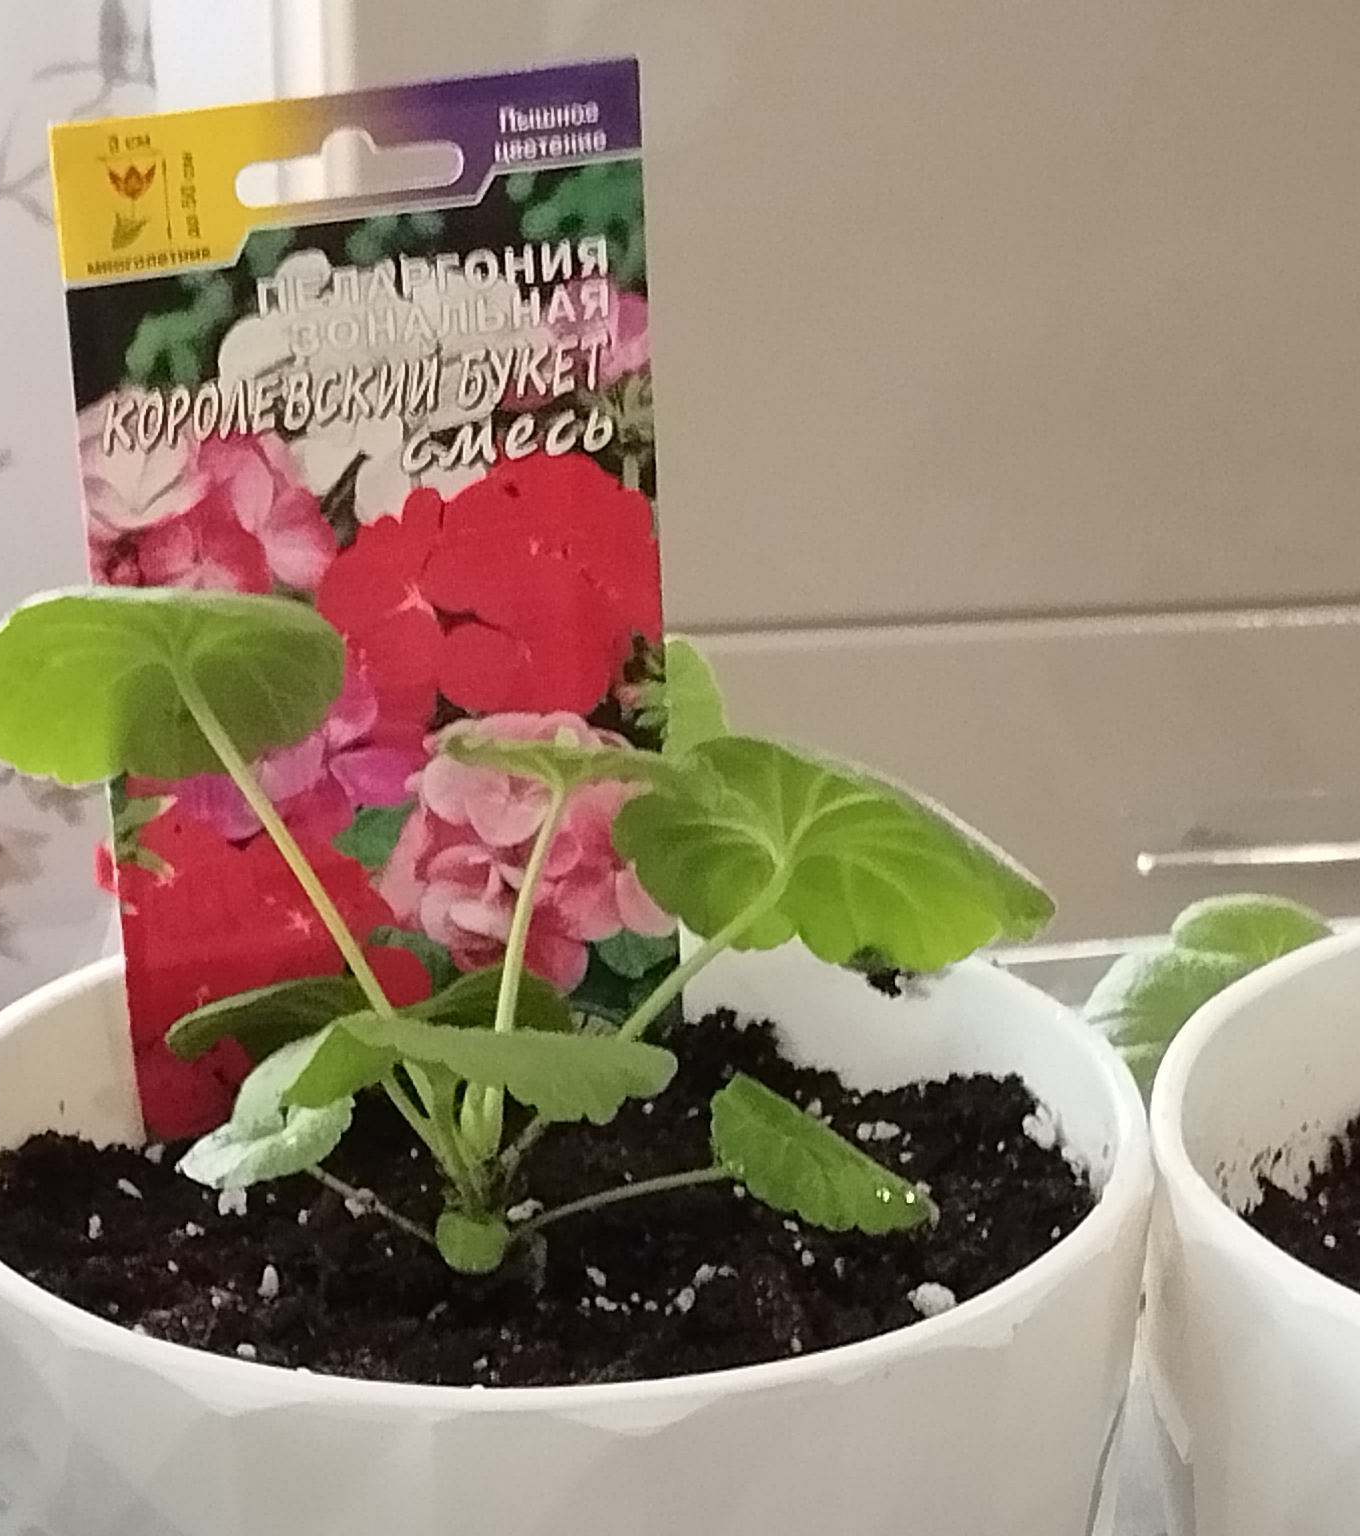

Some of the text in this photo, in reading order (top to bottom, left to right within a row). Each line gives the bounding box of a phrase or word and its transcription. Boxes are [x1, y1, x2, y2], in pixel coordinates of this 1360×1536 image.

[494, 128, 607, 164] цветение
[498, 101, 600, 134] Пышное
[255, 234, 610, 319] ПЕЛАРГОНИЯ
[291, 279, 611, 356] ЗОНАЛЬНАЯ
[103, 335, 612, 453] КОРОЛЕВСКИЙ БУКЕТ
[402, 404, 615, 473] смесь
